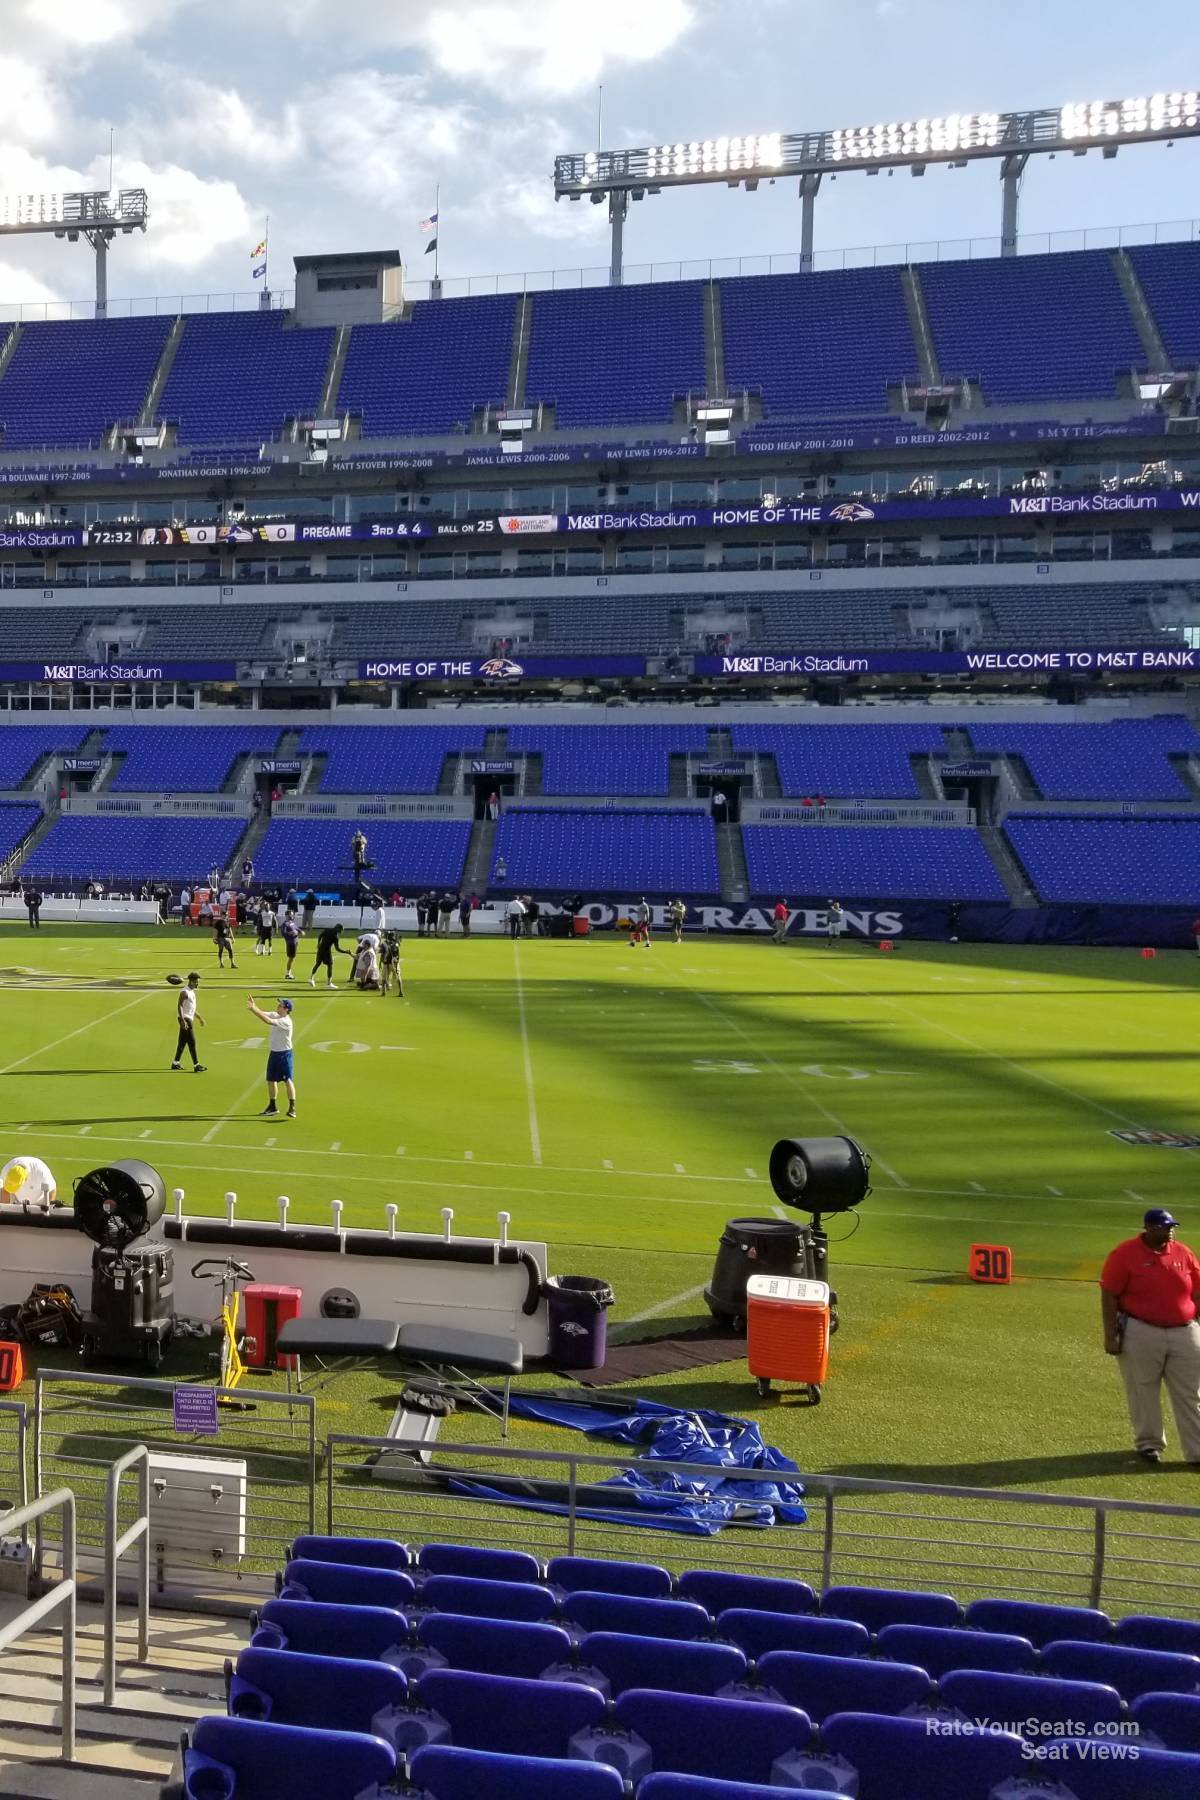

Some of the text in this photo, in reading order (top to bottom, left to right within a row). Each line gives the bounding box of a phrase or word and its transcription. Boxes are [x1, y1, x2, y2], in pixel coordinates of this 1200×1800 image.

[896, 432, 990, 444] ED REED 2002-2012
[1037, 428, 1094, 438] SMYTH
[750, 438, 854, 452] TODD HEAP 2001-2010
[607, 446, 697, 458] RAY LEWIS 1996-2012
[332, 459, 432, 470] MATT STOVER 1996-2008
[466, 453, 570, 466] JAMAL LEWIS 2000-2006
[9, 474, 49, 482] BOULWARE
[50, 472, 90, 481] 1997-2005
[158, 466, 271, 478] JONATHAN OGDEN 1996-2007
[1010, 494, 1156, 514] M&T Bank Stadium
[568, 512, 696, 530] M&T Bank Stadium
[713, 507, 820, 524] HOME OF THE
[276, 528, 287, 539] 0
[302, 526, 352, 538] PREGAME
[371, 523, 422, 536] 3RD & 4
[438, 521, 494, 534] BALL ON 25
[28, 532, 74, 546] Stadium
[94, 532, 132, 544] 72:32
[197, 530, 206, 542] 0
[722, 656, 868, 673] M&T Bank Stadium
[966, 652, 1195, 668] WELCOME TO M&T BANK
[44, 664, 162, 680] M&T Bank Stadium
[366, 662, 472, 677] HOME OF THE
[276, 761, 300, 769] merritt
[486, 761, 512, 769] merritt
[975, 1248, 1008, 1280] 30
